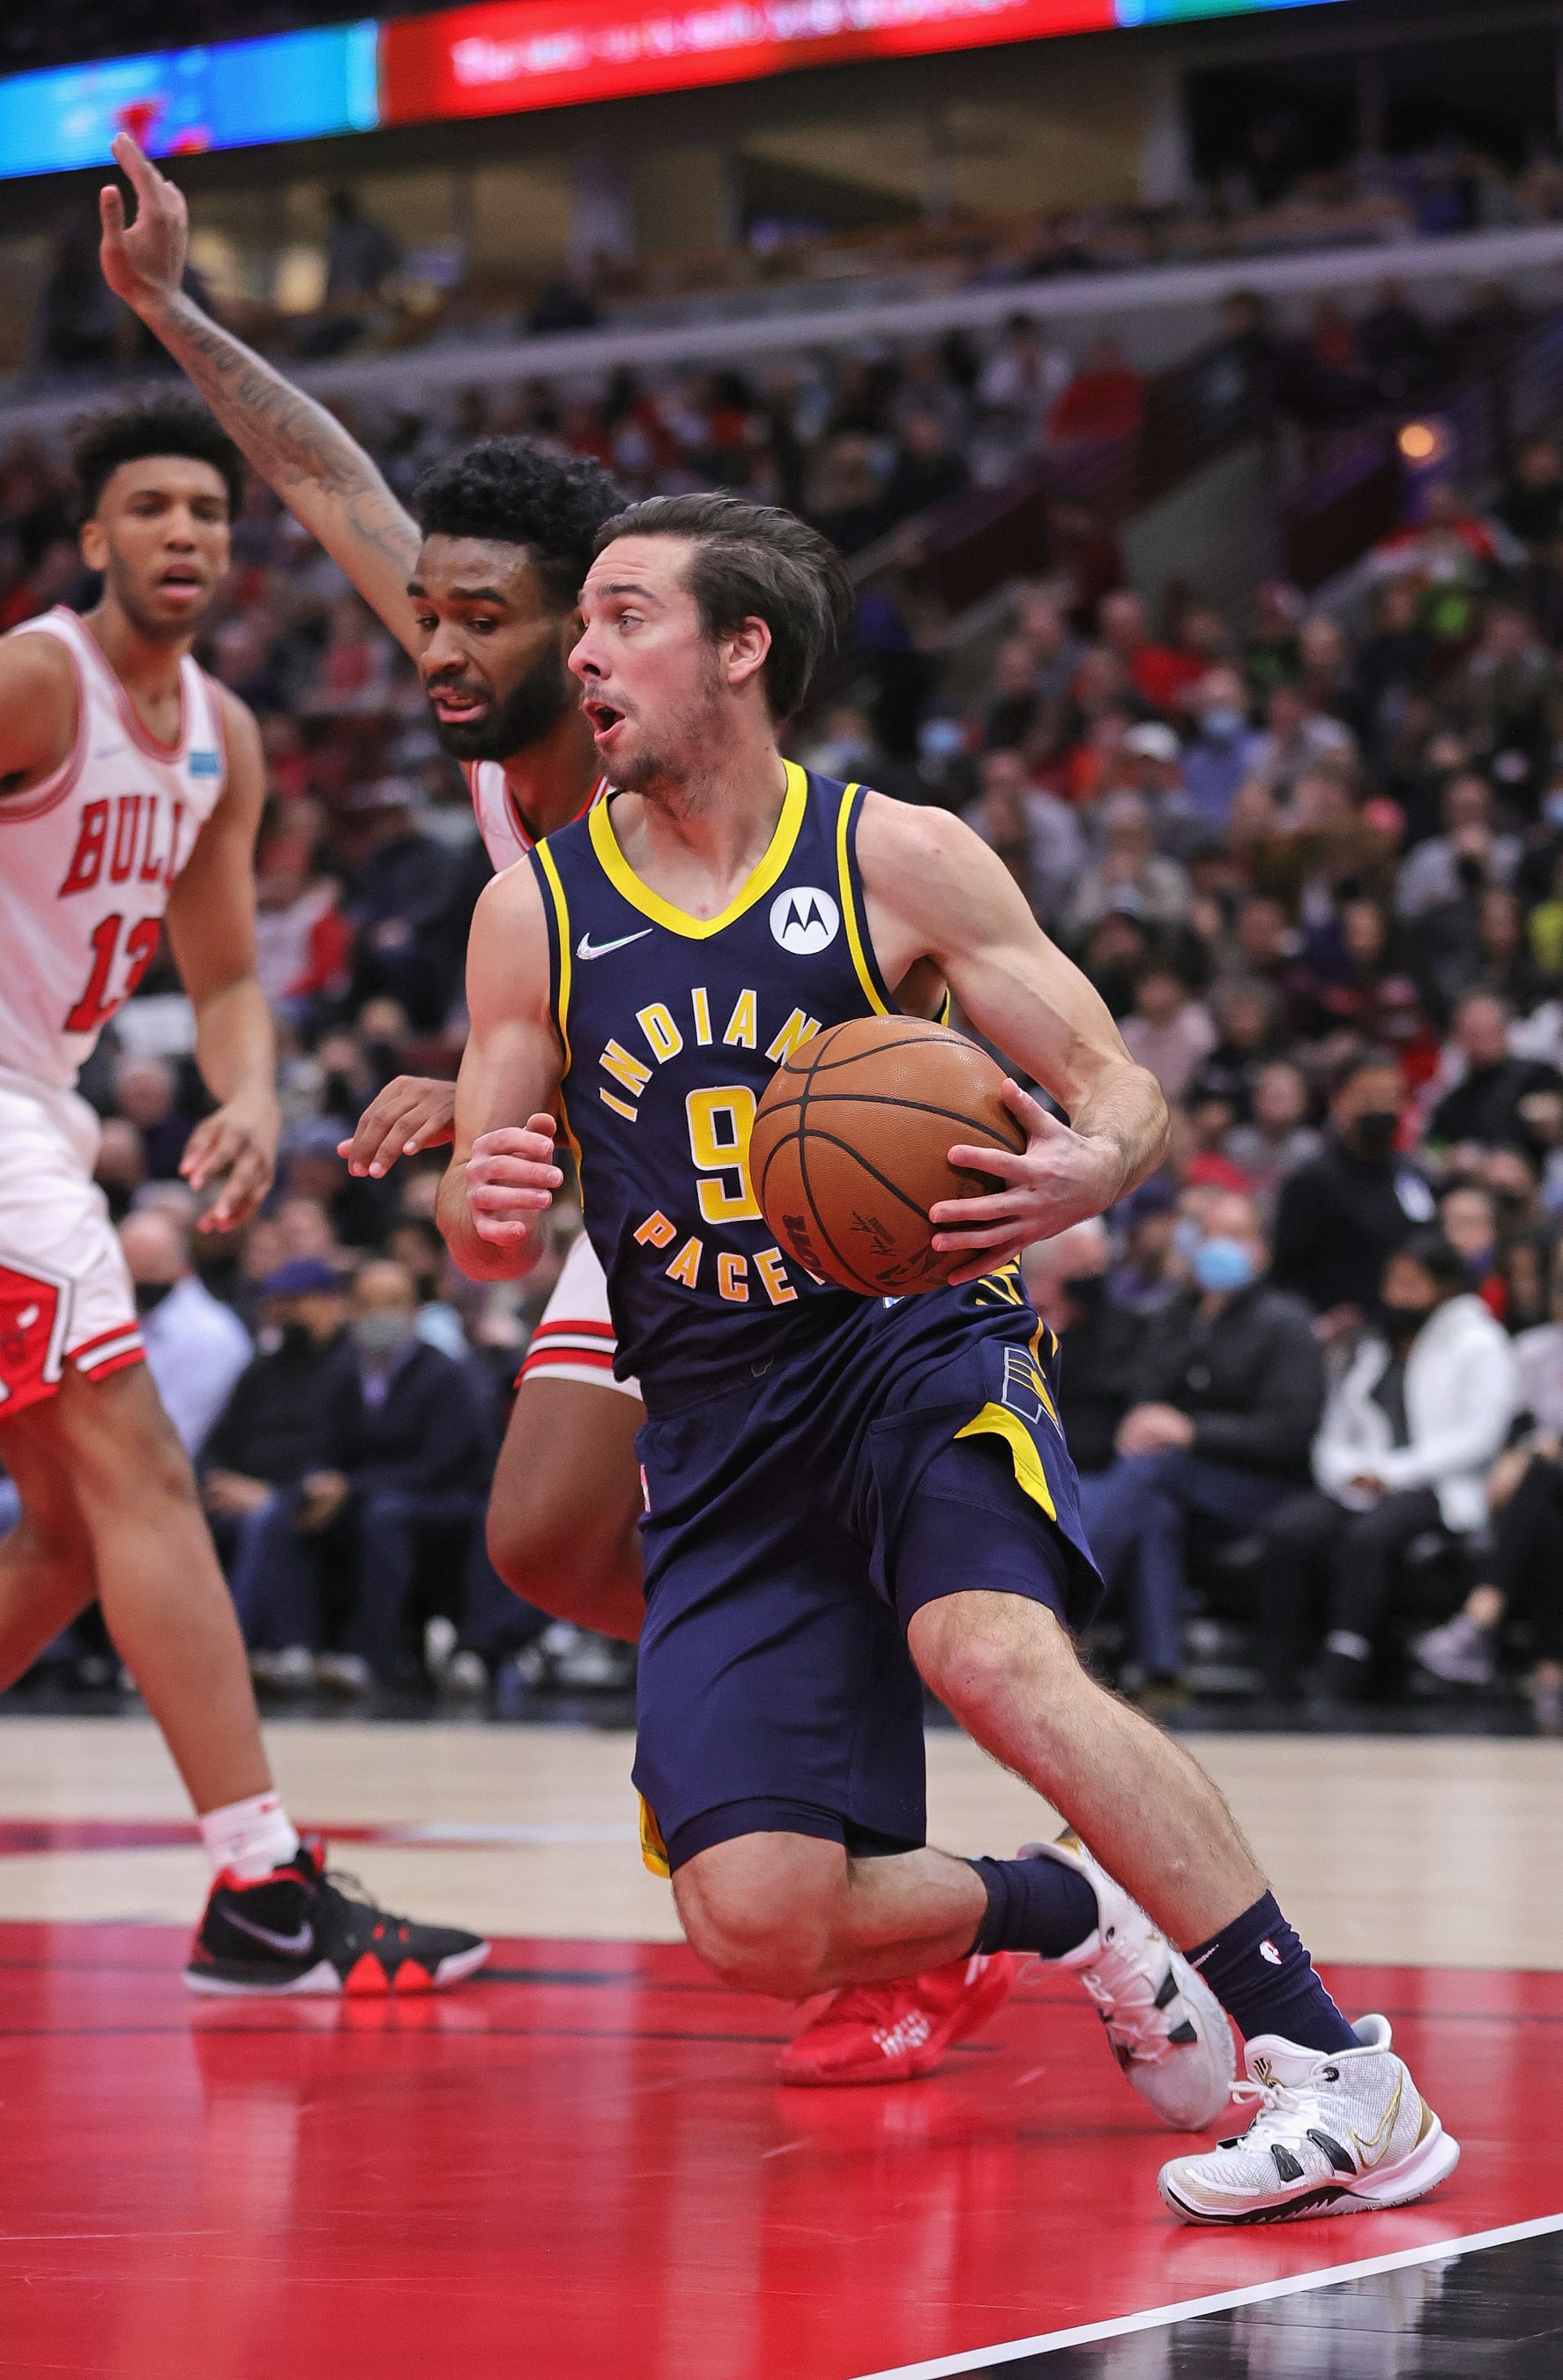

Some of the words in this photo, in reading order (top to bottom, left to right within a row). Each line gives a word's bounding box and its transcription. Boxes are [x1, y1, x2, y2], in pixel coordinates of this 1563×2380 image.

[58, 794, 187, 897] BULL
[63, 913, 162, 1032] 13
[599, 986, 822, 1123] INDIAN
[684, 1084, 763, 1226] 9
[632, 1209, 827, 1306] PACE
